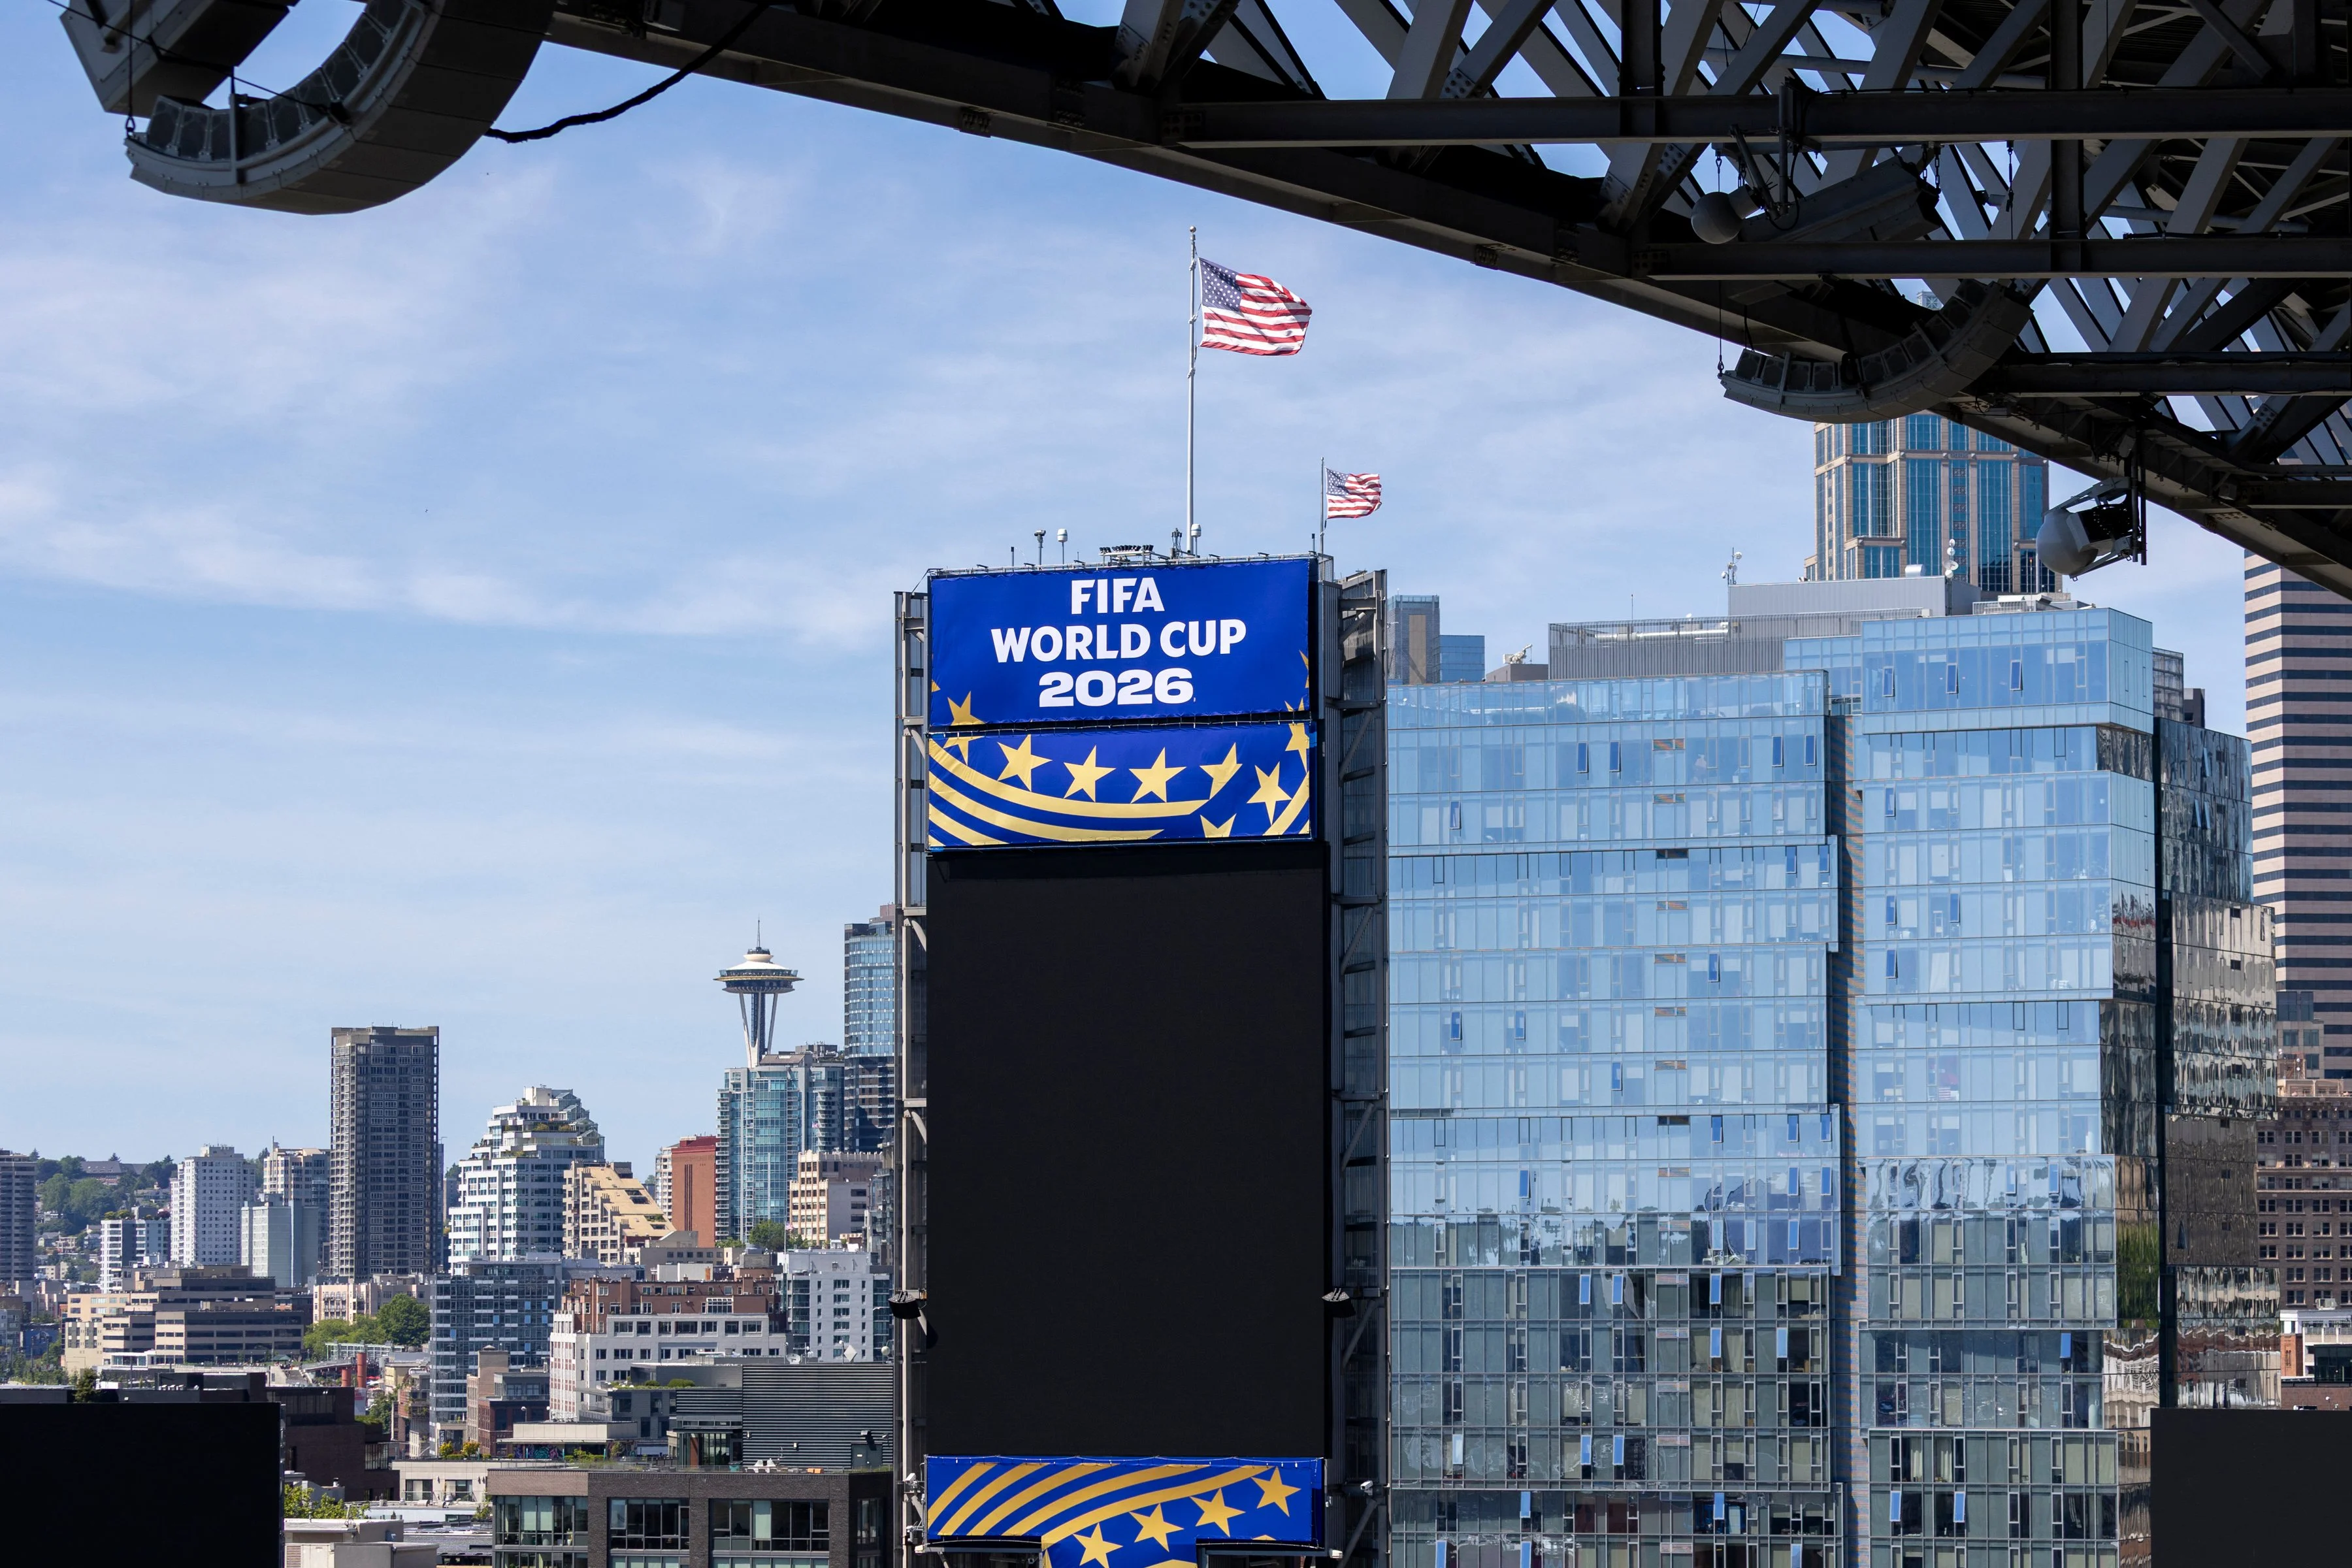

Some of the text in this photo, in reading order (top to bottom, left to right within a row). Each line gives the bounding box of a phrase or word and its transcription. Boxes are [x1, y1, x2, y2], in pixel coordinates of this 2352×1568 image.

[1071, 578, 1165, 615] FIFA
[990, 619, 1247, 663] WORLD CUP
[1039, 668, 1194, 708] 2026
